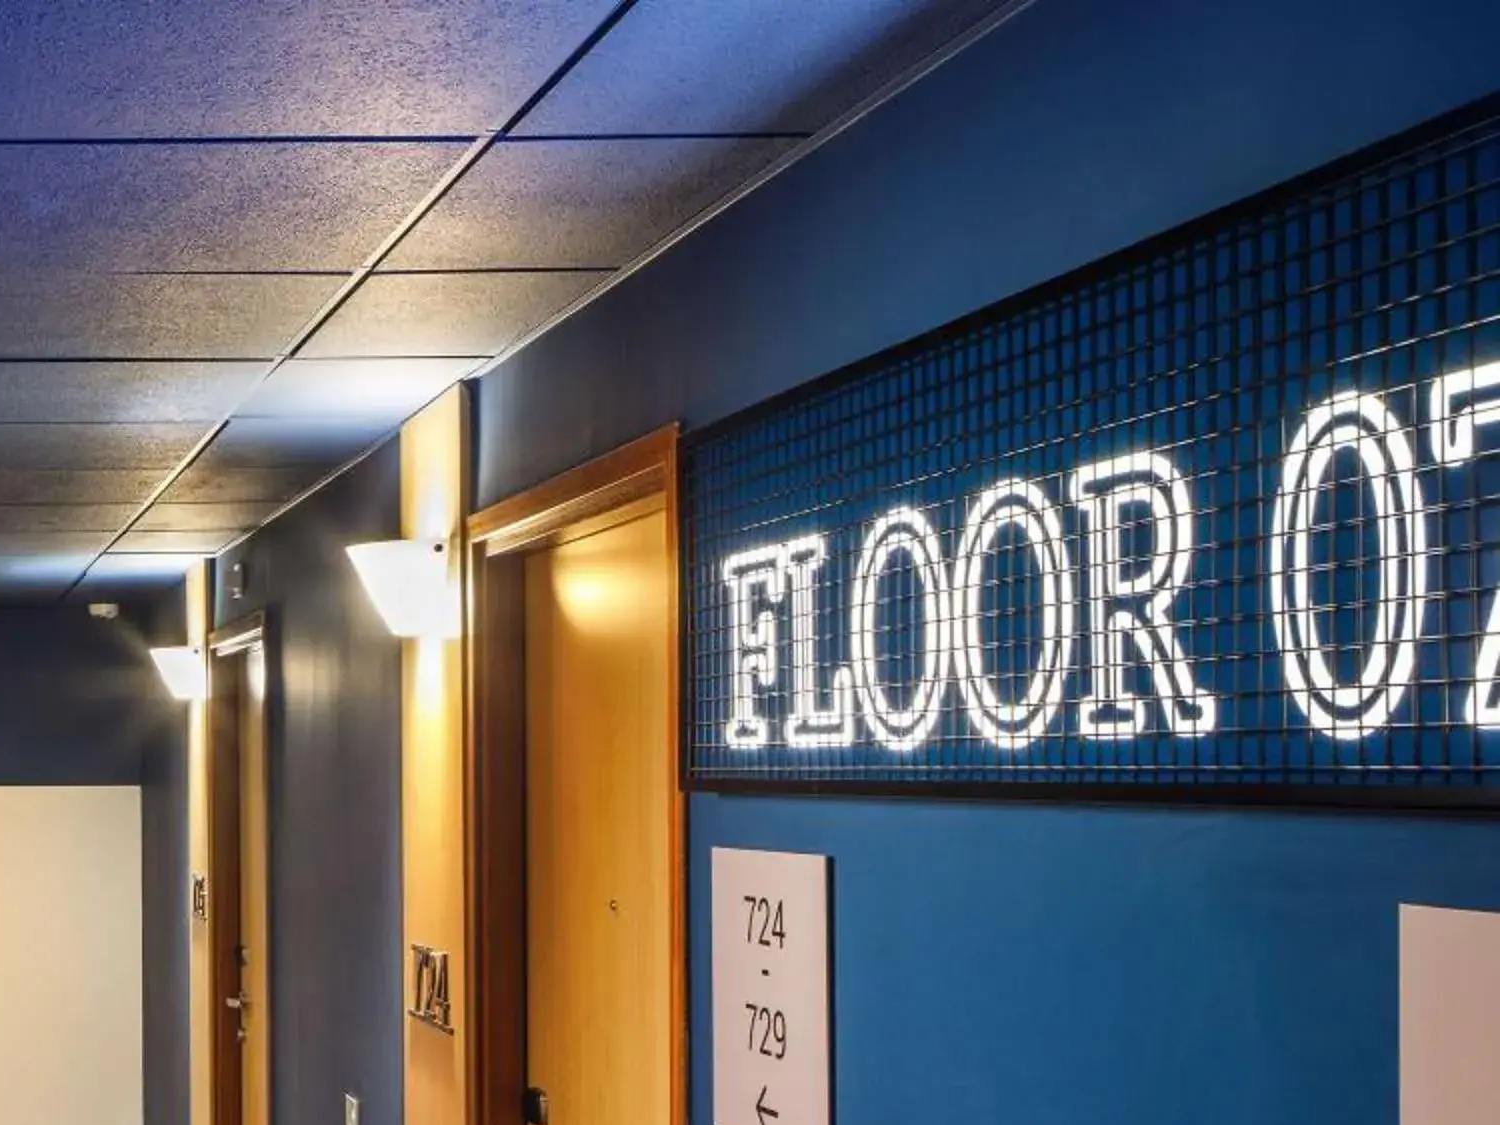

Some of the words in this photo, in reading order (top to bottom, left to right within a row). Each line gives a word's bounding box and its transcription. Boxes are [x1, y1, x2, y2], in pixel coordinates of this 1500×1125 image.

[721, 450, 1216, 751] FLOOR
[744, 896, 786, 949] 724
[408, 943, 454, 1037] 724
[745, 1003, 787, 1061] 729
